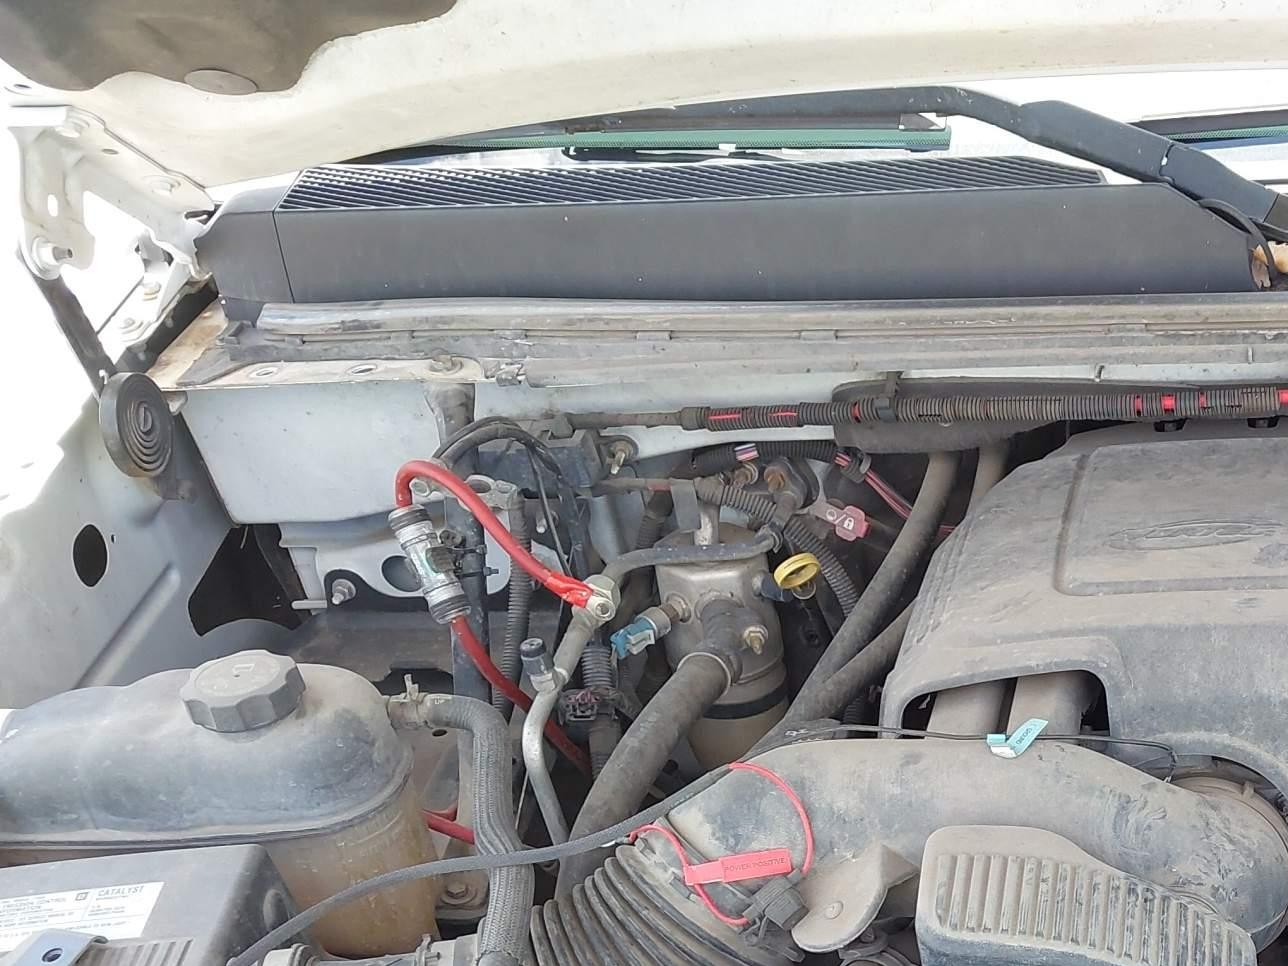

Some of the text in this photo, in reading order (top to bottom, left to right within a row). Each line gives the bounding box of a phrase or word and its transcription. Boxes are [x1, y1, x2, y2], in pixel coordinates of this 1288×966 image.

[724, 857, 785, 873] POWER POSITIVE
[98, 885, 145, 897] CATALYST
